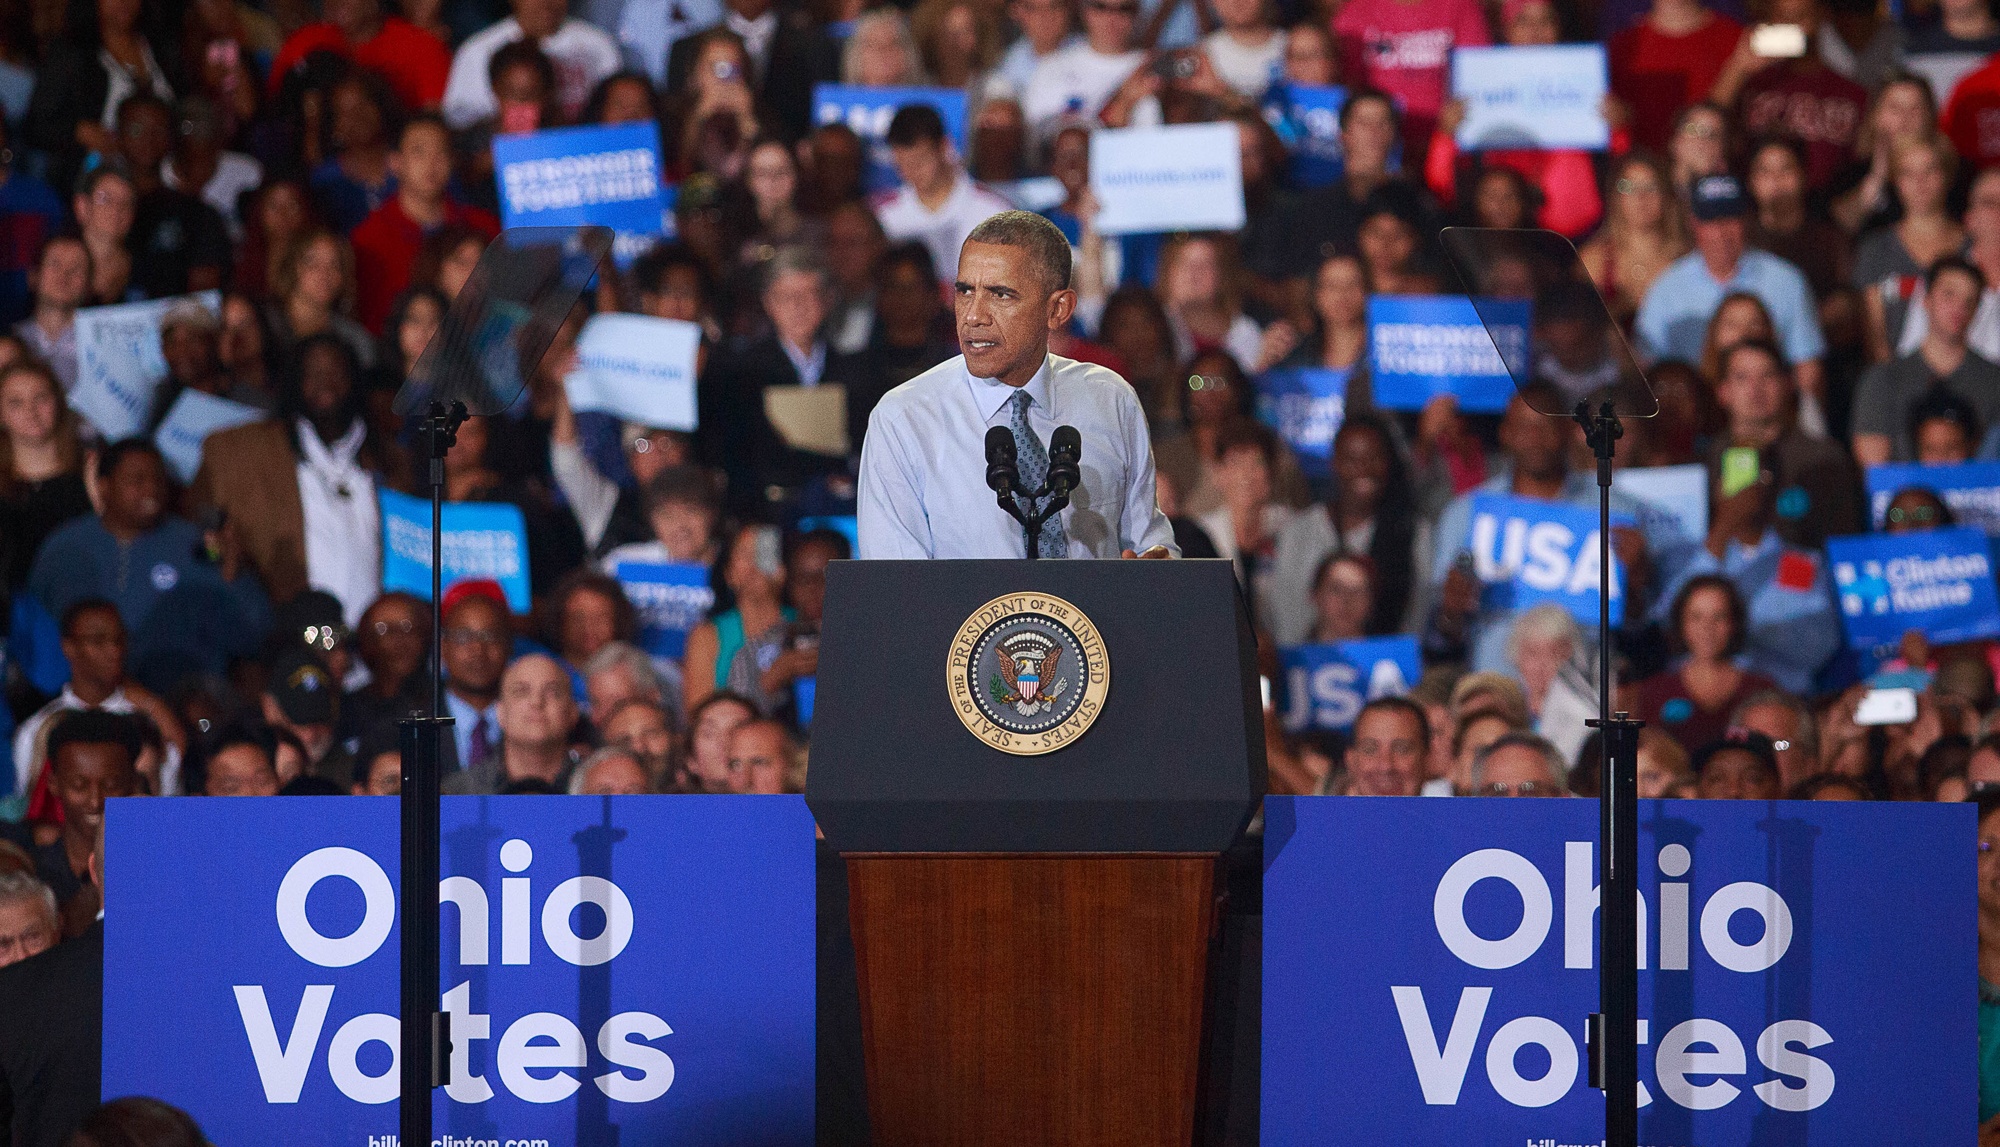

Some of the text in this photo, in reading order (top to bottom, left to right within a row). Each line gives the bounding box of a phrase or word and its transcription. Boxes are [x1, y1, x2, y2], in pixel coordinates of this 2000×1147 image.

[503, 148, 655, 184] STRONGER
[506, 172, 657, 214] TOGETHER
[1374, 323, 1525, 347] STRONGER
[1377, 346, 1525, 375] TOGETHER
[1472, 512, 1621, 599] USA
[1887, 553, 1990, 584] Clinton
[1891, 582, 1973, 612] Kaine
[953, 598, 1105, 747] SEAL OF THE PRESIDENT OF THE UNITED STATES
[1433, 841, 1793, 973] Ohio
[232, 980, 676, 1104] Votes
